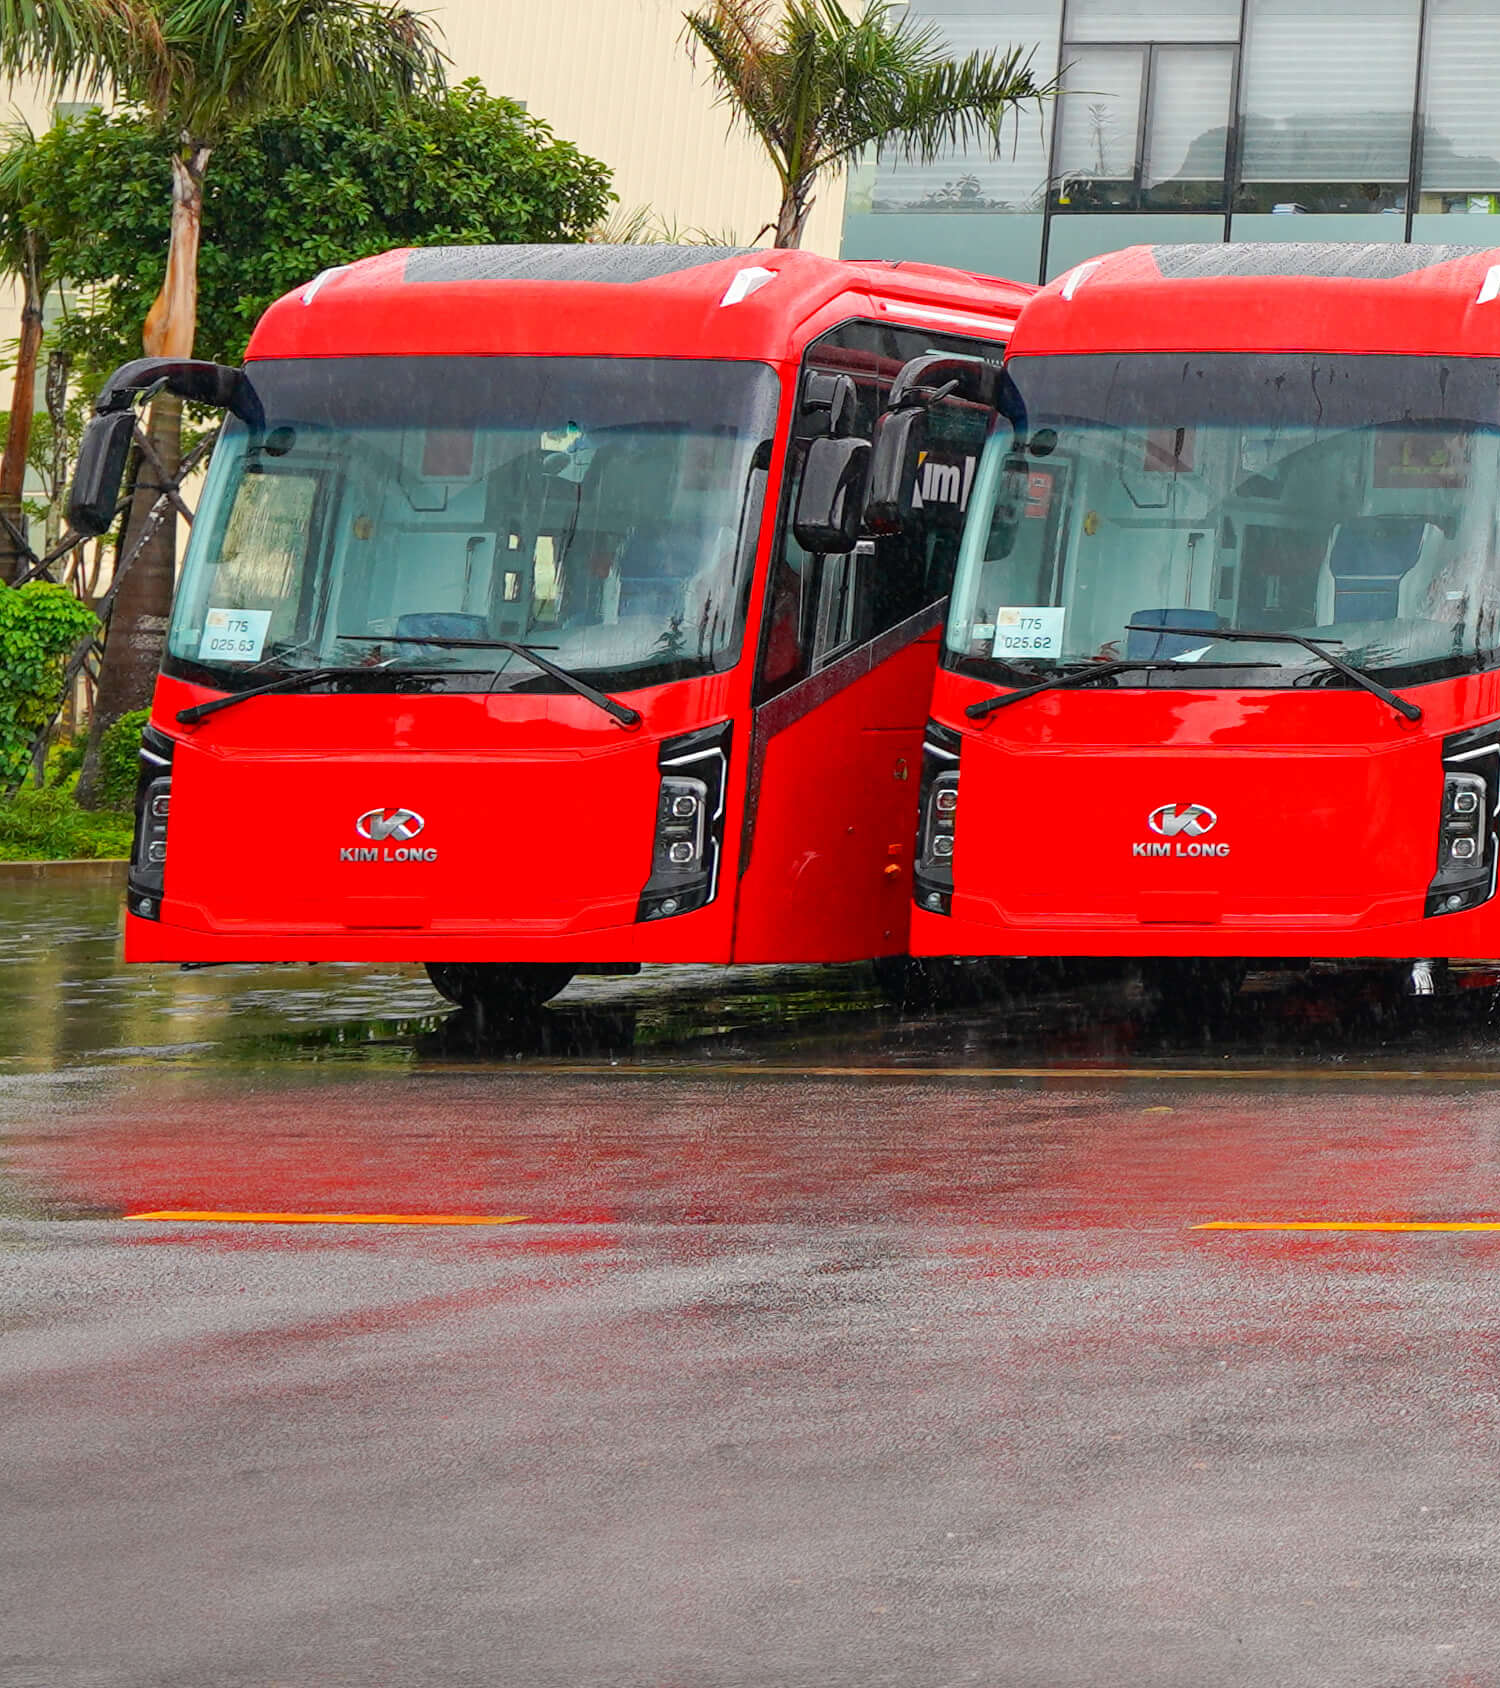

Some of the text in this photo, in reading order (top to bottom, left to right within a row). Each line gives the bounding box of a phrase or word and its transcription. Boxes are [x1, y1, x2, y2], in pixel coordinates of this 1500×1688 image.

[227, 620, 249, 632] T75
[1020, 618, 1043, 630] T75
[1005, 637, 1052, 649] 025.62
[340, 847, 438, 862] KIM LONG
[1132, 842, 1231, 857] KIM LONG
